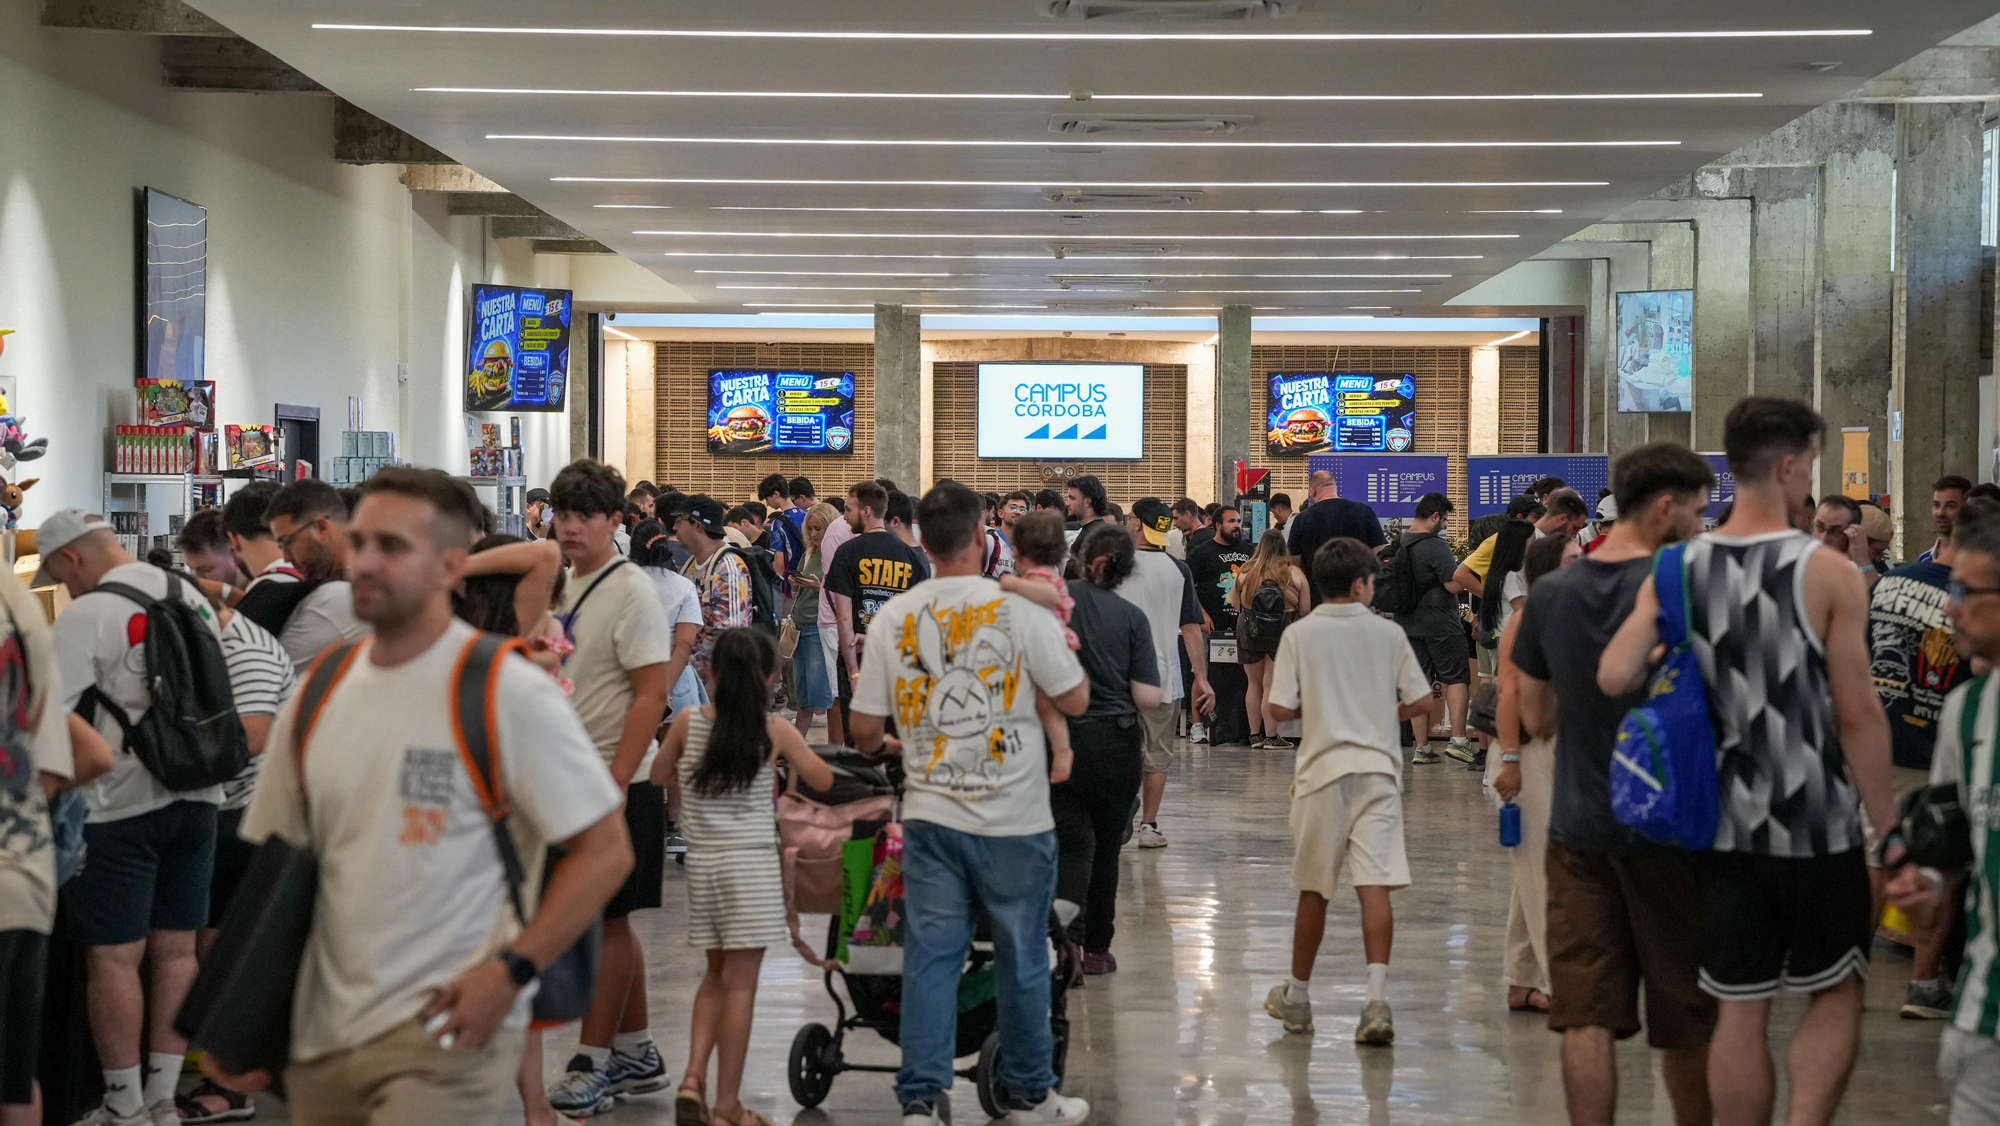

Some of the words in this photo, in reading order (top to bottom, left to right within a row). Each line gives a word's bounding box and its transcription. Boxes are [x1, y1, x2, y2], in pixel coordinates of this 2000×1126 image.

[481, 292, 516, 318] NUESTRA
[522, 296, 542, 311] MENÚ
[482, 311, 514, 341] CARTA
[524, 356, 542, 366] BEBIDA
[720, 374, 769, 392] NUESTRA
[780, 376, 809, 386] MENÚ
[1280, 376, 1329, 394] NUESTRA
[1340, 379, 1369, 388] MENÚ
[722, 386, 770, 407] CARTA
[1015, 384, 1107, 402] CAMPUS
[1282, 389, 1330, 410] CARTA
[1015, 401, 1106, 417] CÓRDOBA
[1400, 473, 1435, 481] CAMPUS
[1219, 552, 1249, 562] Pokémon
[859, 558, 912, 588] STAFF
[1900, 578, 1953, 608] SOUTHW
[1894, 595, 1955, 634] FINES
